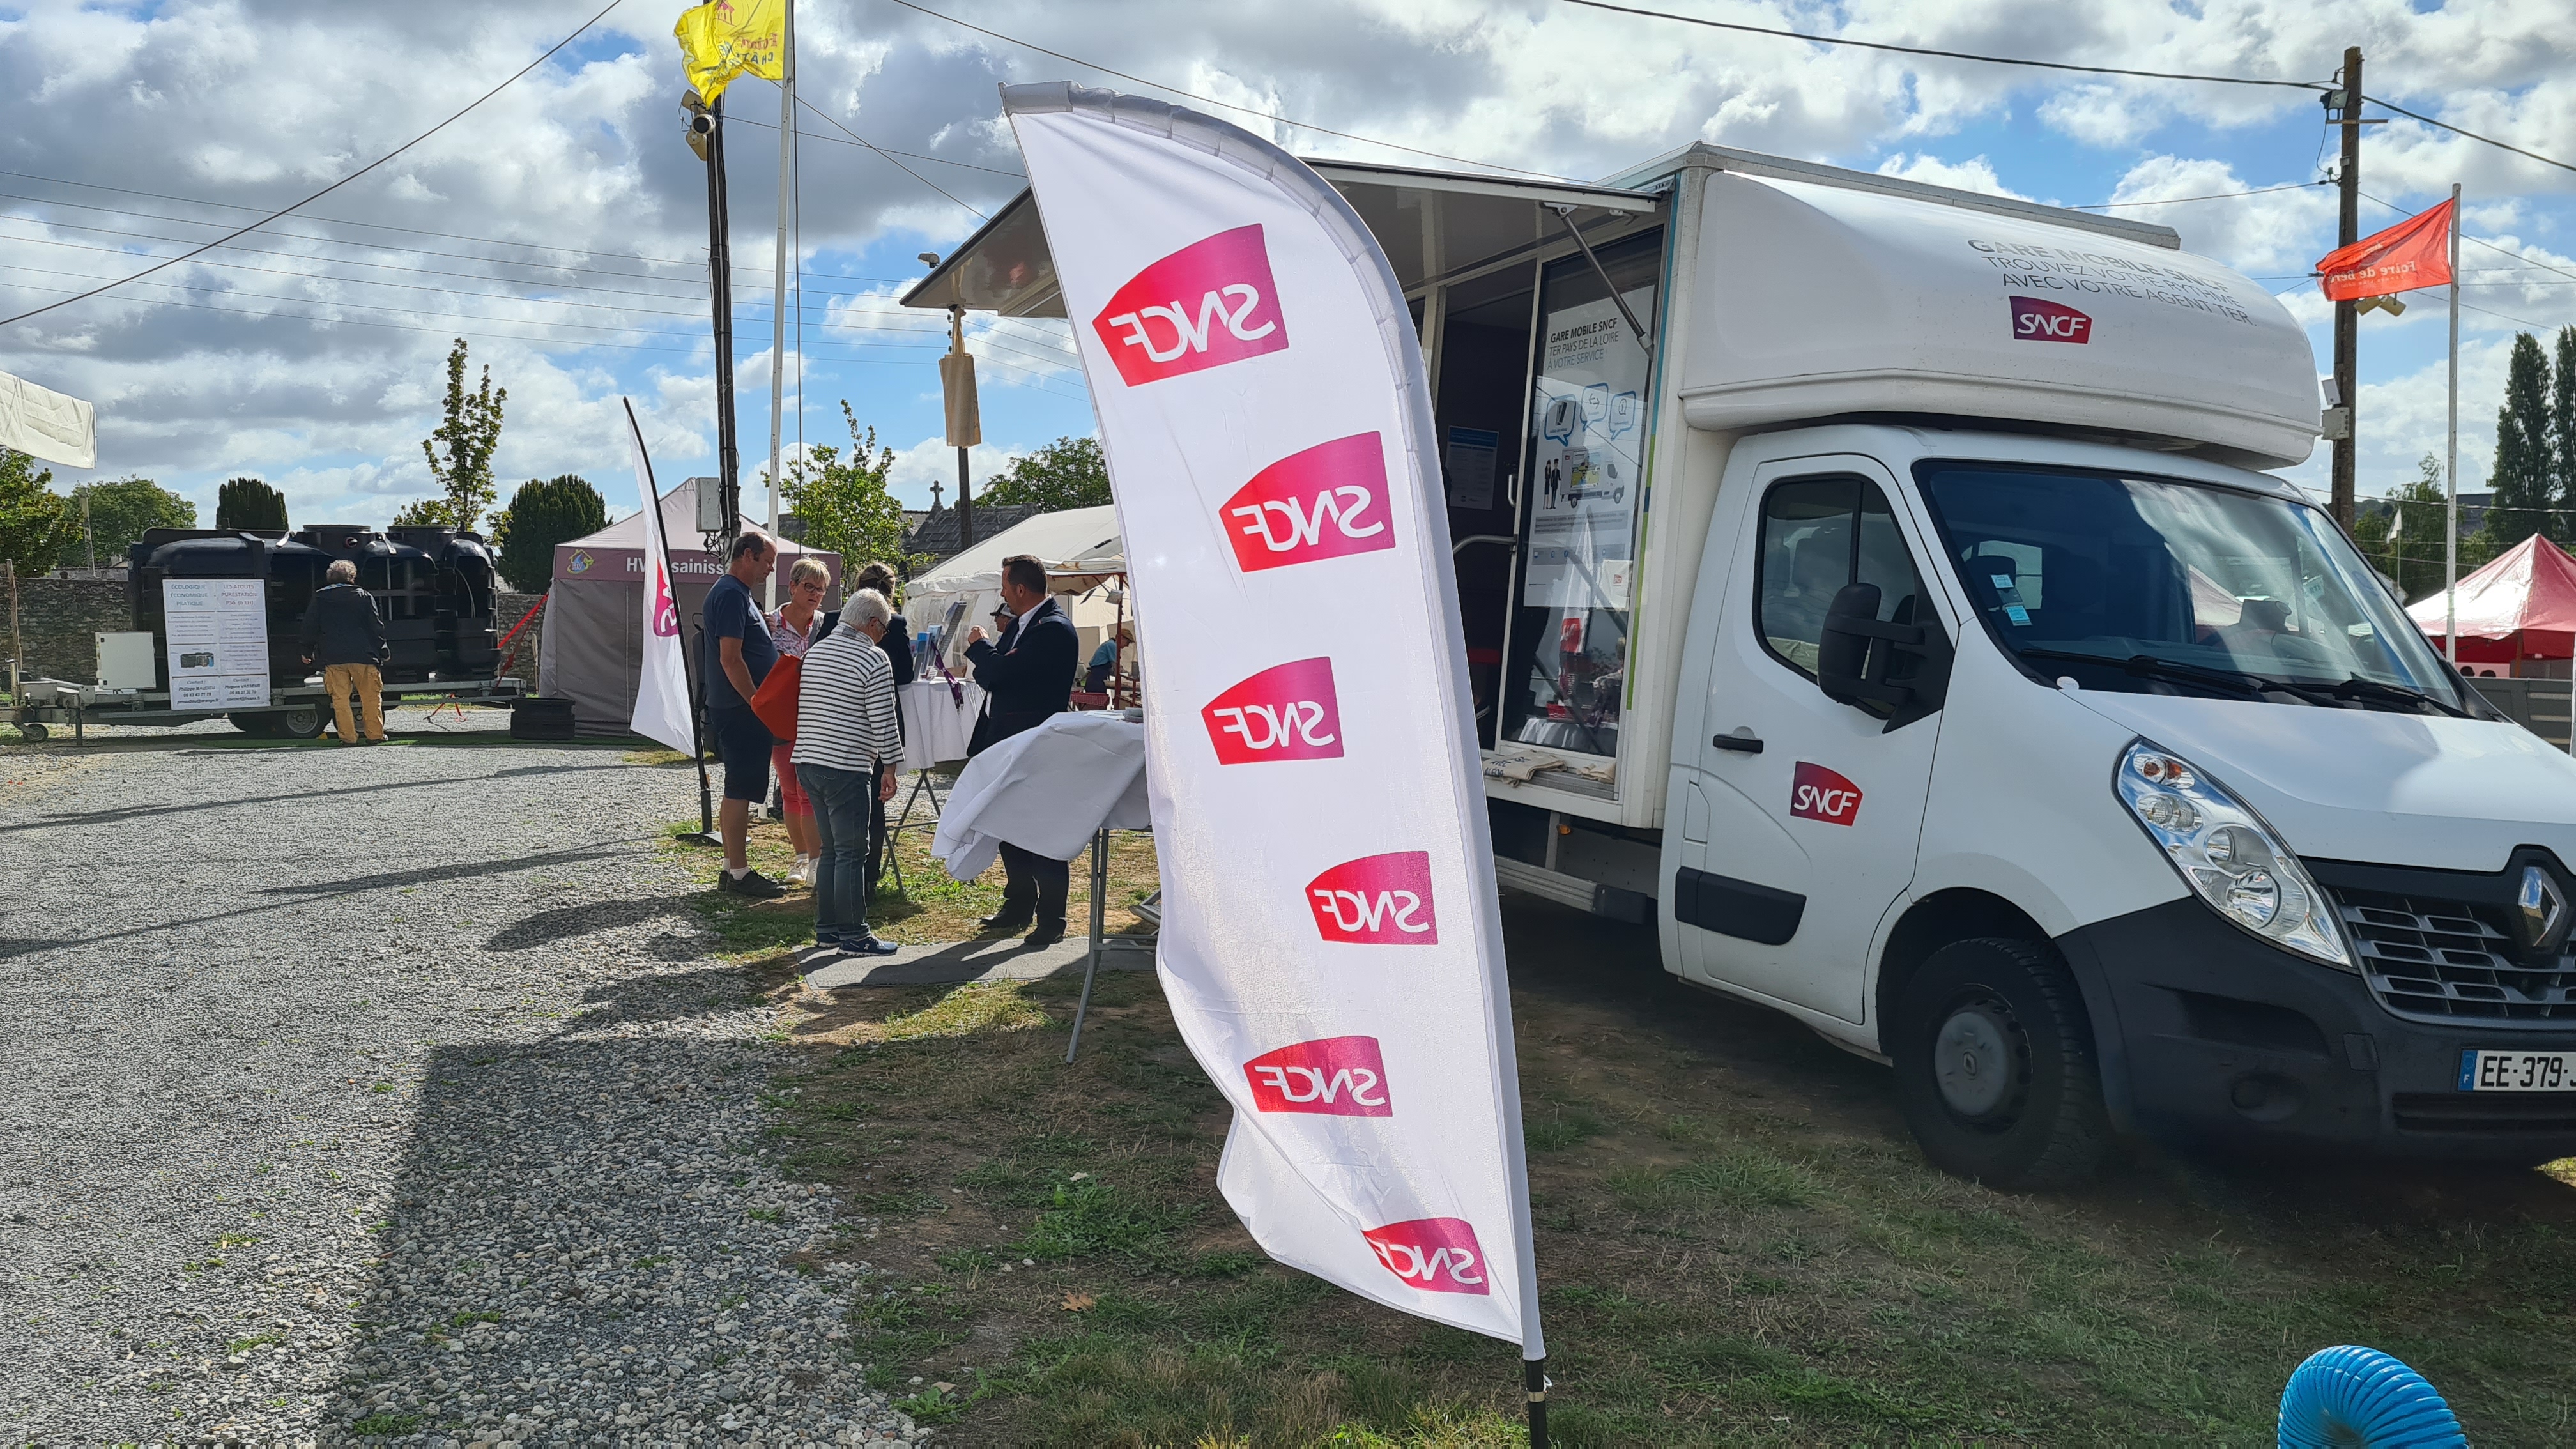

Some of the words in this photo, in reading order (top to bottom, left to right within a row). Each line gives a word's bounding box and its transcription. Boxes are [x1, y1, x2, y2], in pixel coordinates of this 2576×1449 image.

[1968, 240, 2055, 259] GARE
[2054, 248, 2165, 277] MOBILE
[2163, 268, 2228, 293] SNCF
[1981, 256, 2092, 277] TROUVEZ
[2089, 266, 2165, 288] VOTRE
[2163, 279, 2244, 309] RYTHME
[2004, 273, 2064, 289] AVEC
[2062, 277, 2142, 298] VOTRE
[2146, 288, 2212, 313] AGENT
[1551, 330, 1569, 343] GARE
[1570, 323, 1597, 339] MOBILE
[1598, 318, 1618, 332] SNCF
[2017, 313, 2087, 337] SNCF
[1549, 345, 1561, 356] TER
[1561, 341, 1577, 353] PAYS
[1578, 338, 1588, 350] DE
[1590, 336, 1598, 348] LA
[1599, 331, 1620, 346] LOIRE
[1554, 354, 1575, 369] VOTRE
[1576, 348, 1604, 364] SERVICE
[671, 558, 724, 575] sainiss
[1793, 785, 1857, 816] SNCF
[2464, 1074, 2470, 1084] F
